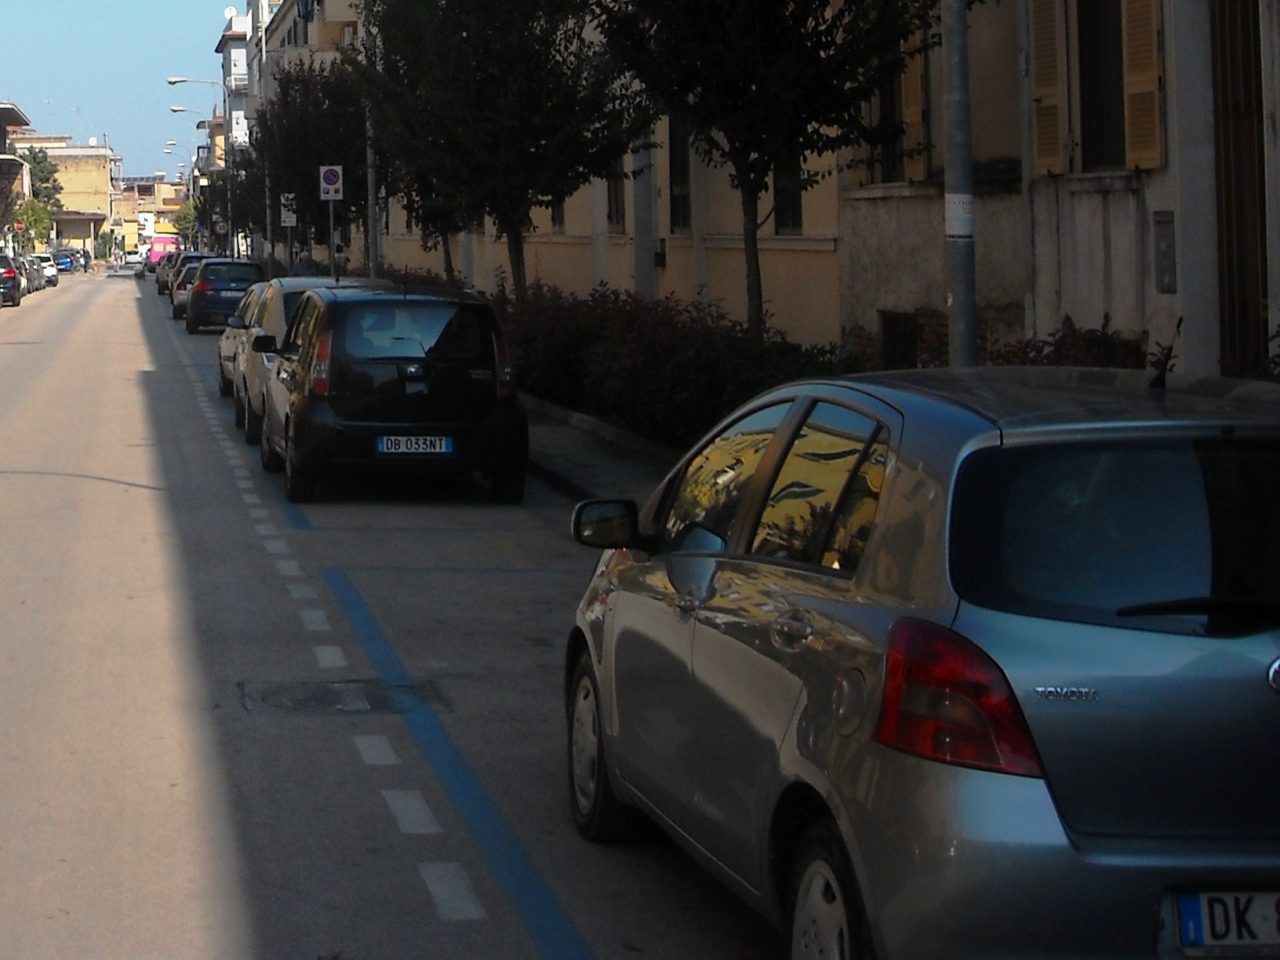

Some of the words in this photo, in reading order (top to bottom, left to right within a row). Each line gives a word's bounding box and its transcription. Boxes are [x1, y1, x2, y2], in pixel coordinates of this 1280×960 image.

[385, 438, 401, 451] DB
[1035, 687, 1100, 701] TOYOTA
[1207, 896, 1259, 941] DK
